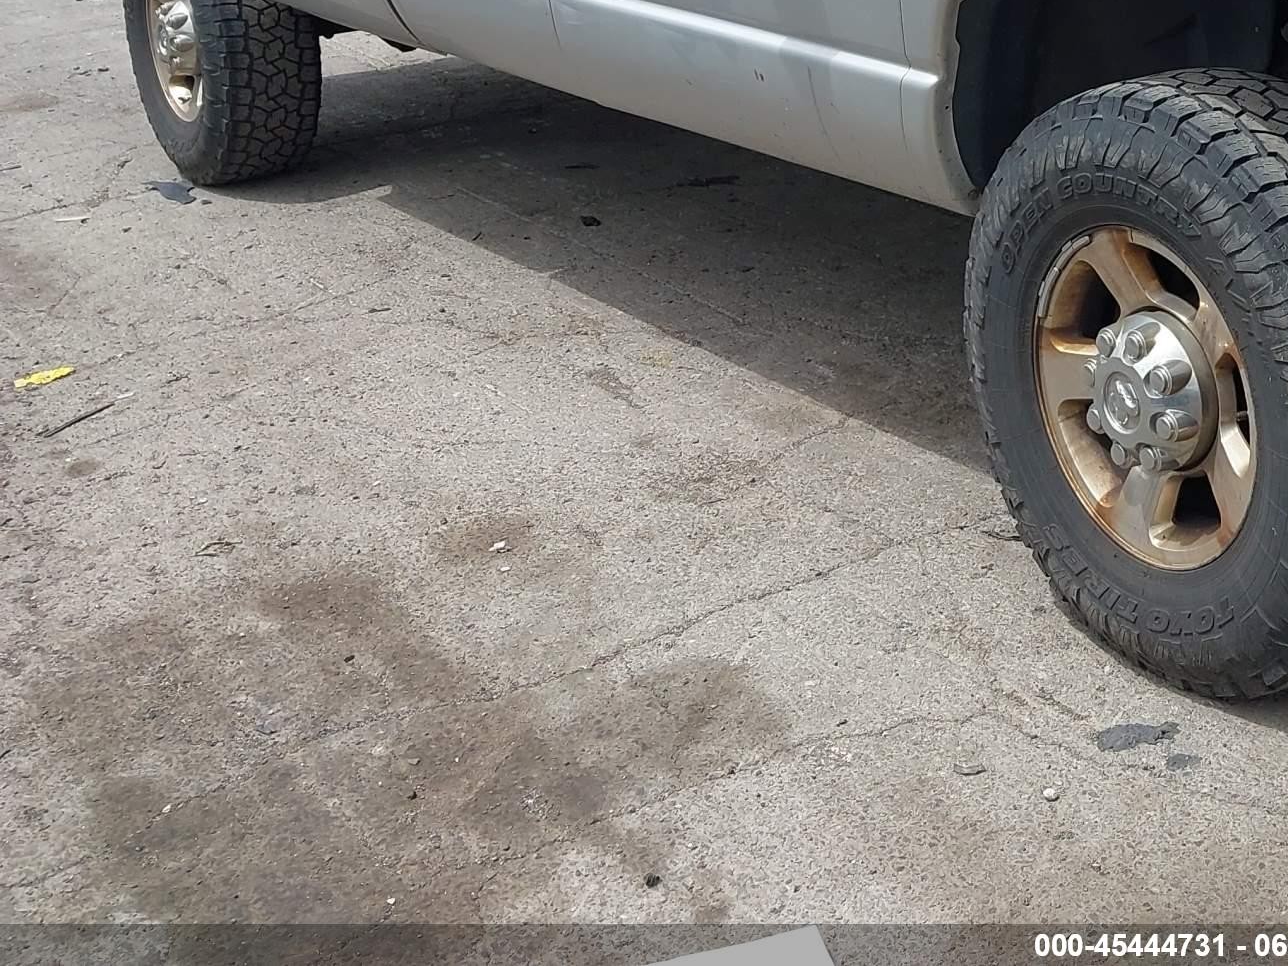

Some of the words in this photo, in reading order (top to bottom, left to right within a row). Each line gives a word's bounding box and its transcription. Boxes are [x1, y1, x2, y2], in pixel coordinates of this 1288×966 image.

[1001, 186, 1054, 274] OPEN
[1056, 172, 1201, 236] COUNTRY
[1147, 595, 1234, 635] TOYO
